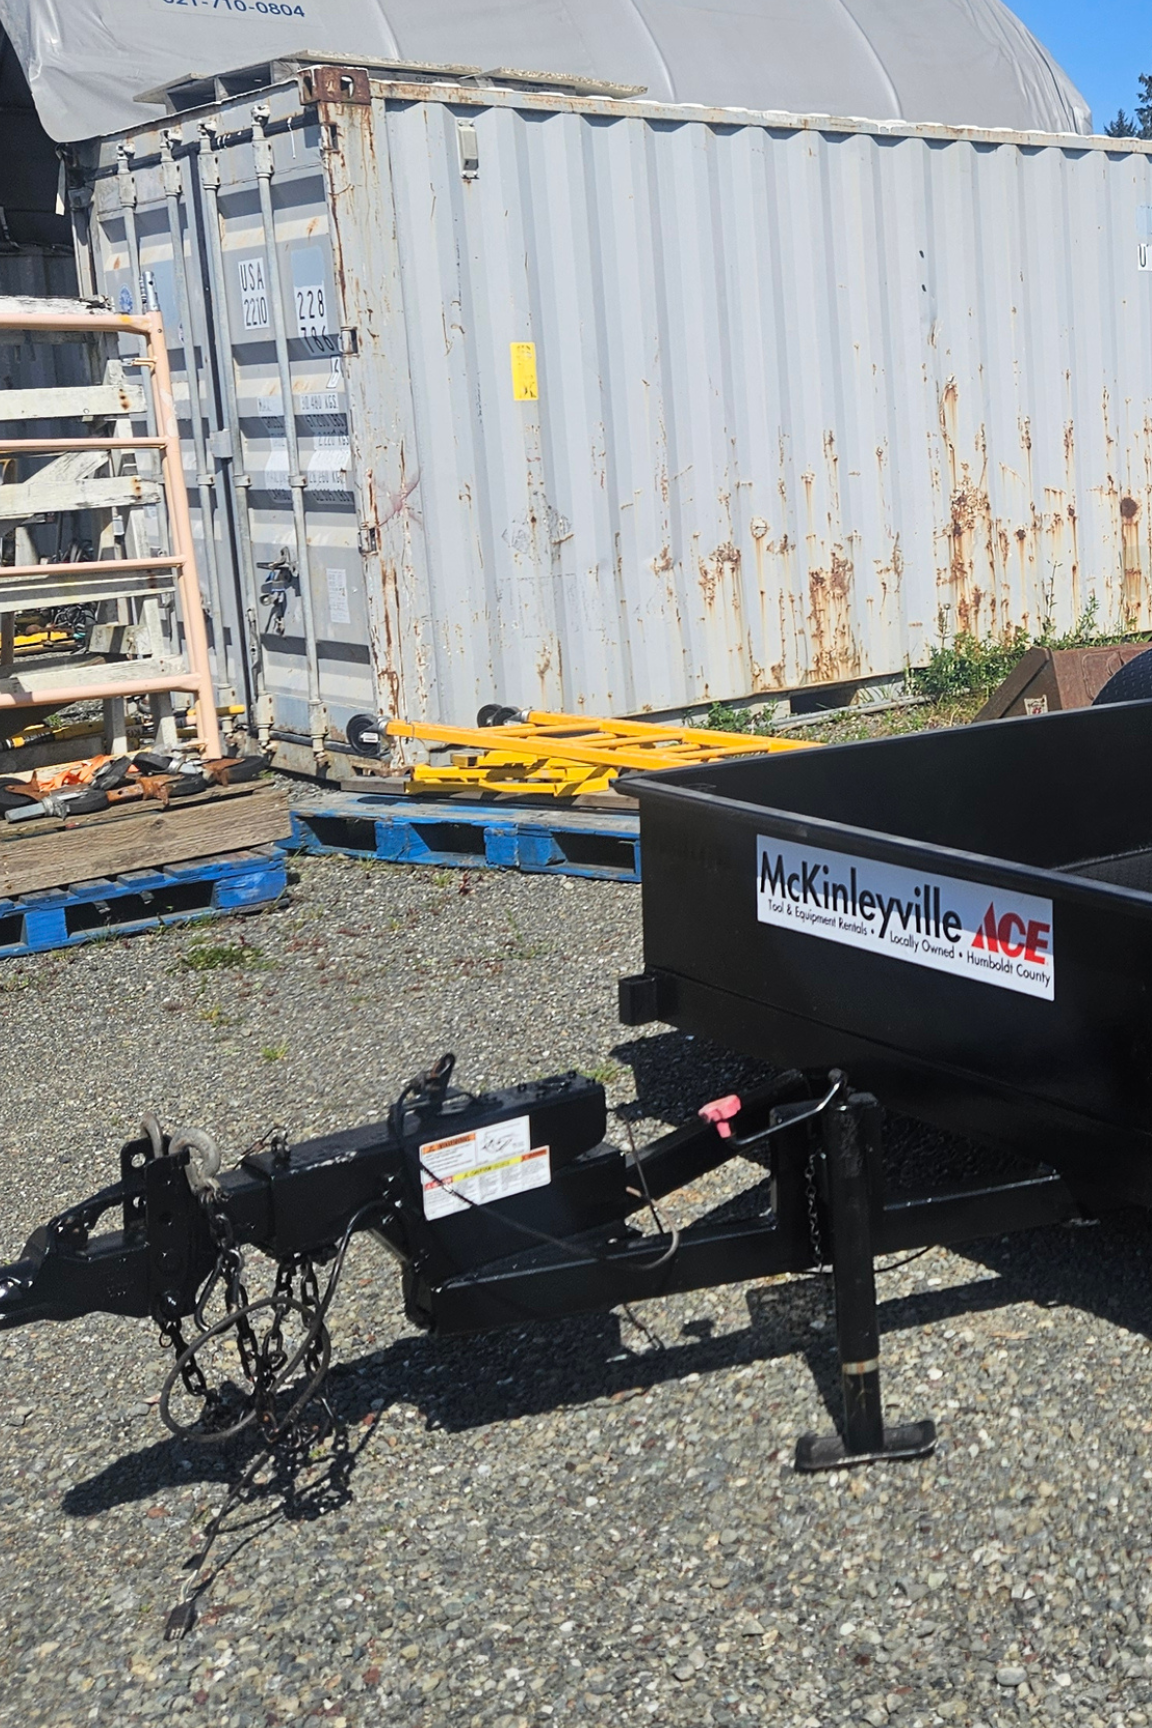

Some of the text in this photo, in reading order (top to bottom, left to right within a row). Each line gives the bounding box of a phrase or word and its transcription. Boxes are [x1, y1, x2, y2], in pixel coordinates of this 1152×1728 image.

[240, 262, 264, 291] USA
[244, 296, 268, 326] 2210
[297, 289, 324, 319] 228
[301, 325, 335, 353] 786
[760, 850, 1050, 965] McKinleyville ACE
[768, 899, 1051, 988] Tool & Equipment Rentals Locally Owned Humboldt County
